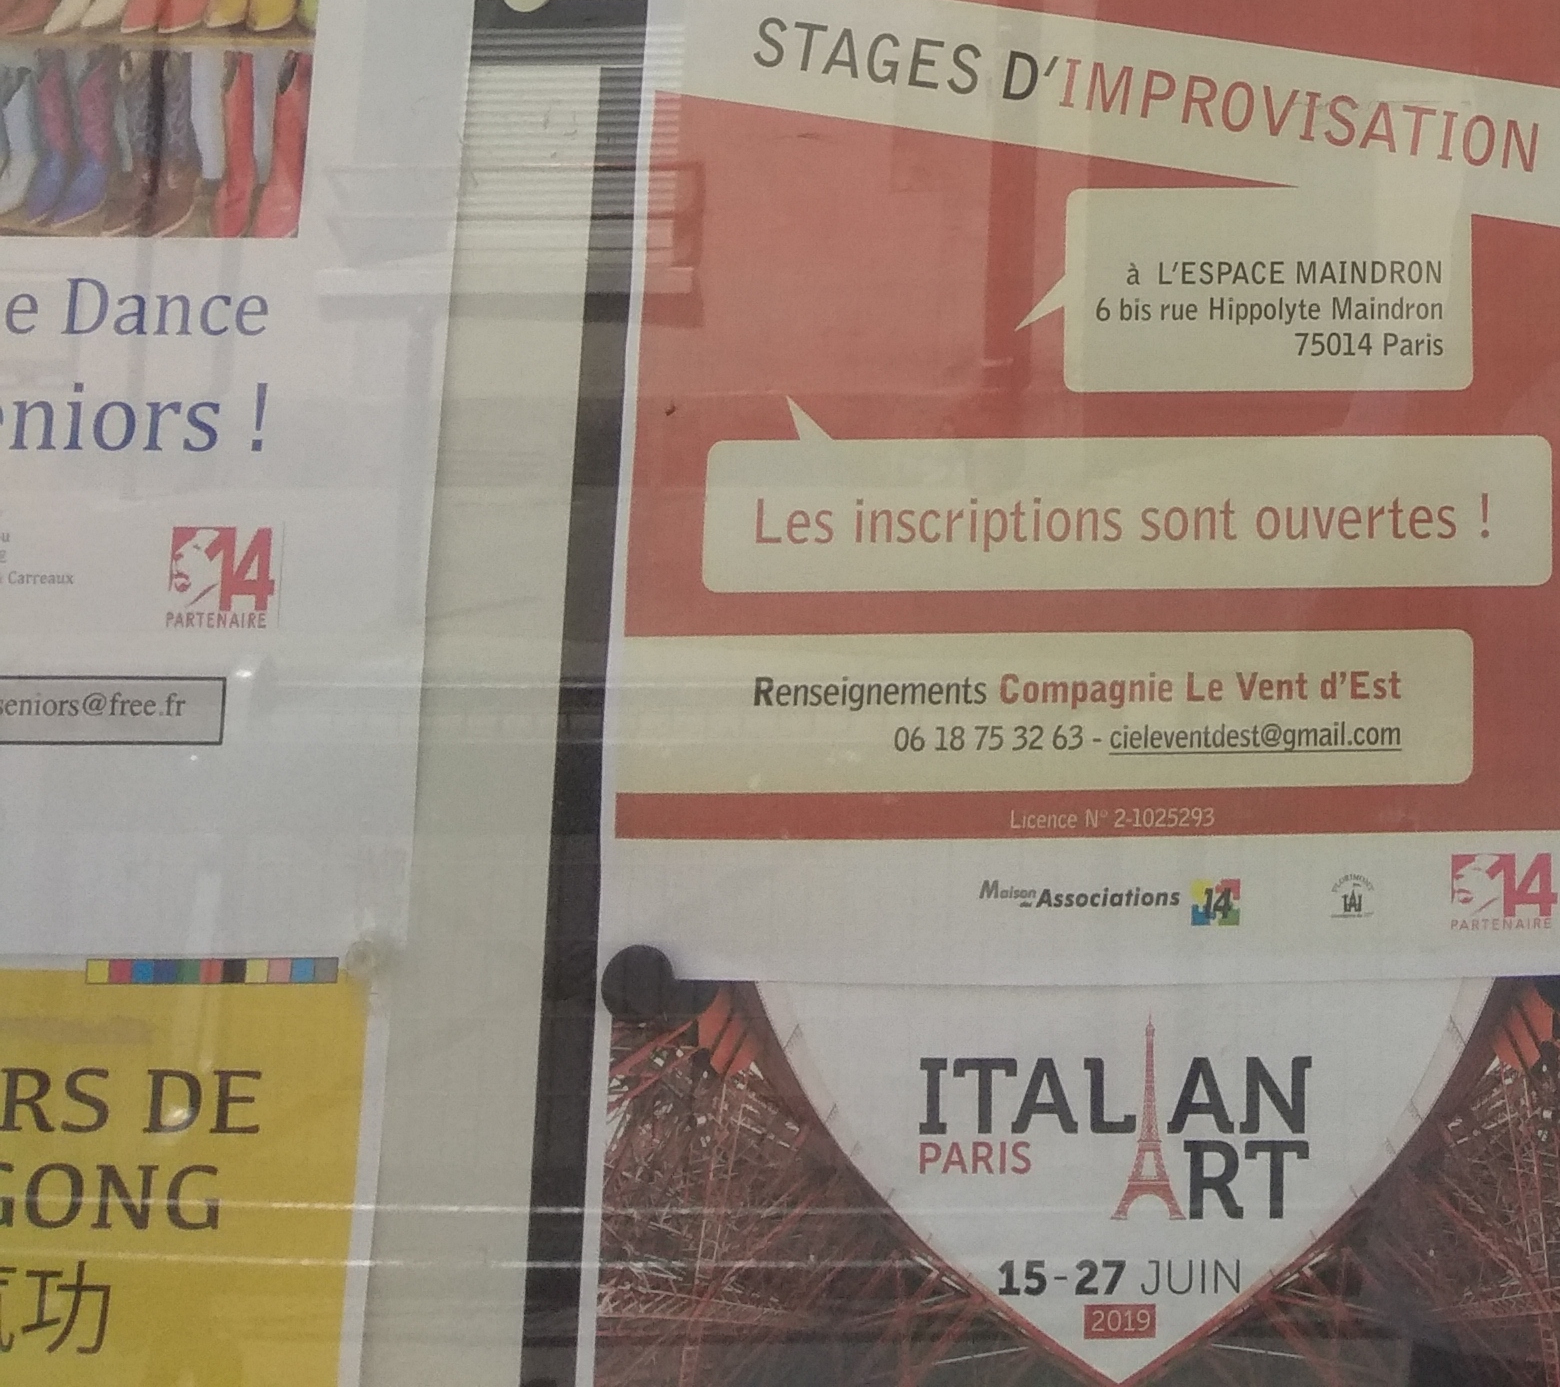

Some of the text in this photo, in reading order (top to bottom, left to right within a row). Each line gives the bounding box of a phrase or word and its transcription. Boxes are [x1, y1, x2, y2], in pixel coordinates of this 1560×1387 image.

[752, 15, 1541, 175] STAGES D'IMPROVISATION
[1157, 259, 1444, 287] L'ESPACE MAINDRON
[61, 277, 269, 336] Dance
[1207, 295, 1444, 325] Hippolyte Maindron
[1382, 330, 1444, 358] Paris
[754, 496, 1458, 553] Les inscriptions sont ouvertes
[166, 611, 267, 628] PARTENAIRE
[753, 670, 1402, 711] Renseignements Compagnie Le Vent d'Est
[1108, 721, 1402, 753] cieleventdest@gmail.com
[1010, 807, 1215, 829] Licence 2-1025293
[1037, 886, 1180, 909] Associations
[1451, 917, 1553, 930] PARTENAIRE
[0, 1067, 262, 1134] RS DE
[919, 1140, 1032, 1175] PARIS
[1141, 1258, 1241, 1295] JUIN
[1090, 1309, 1152, 1333] 2019
